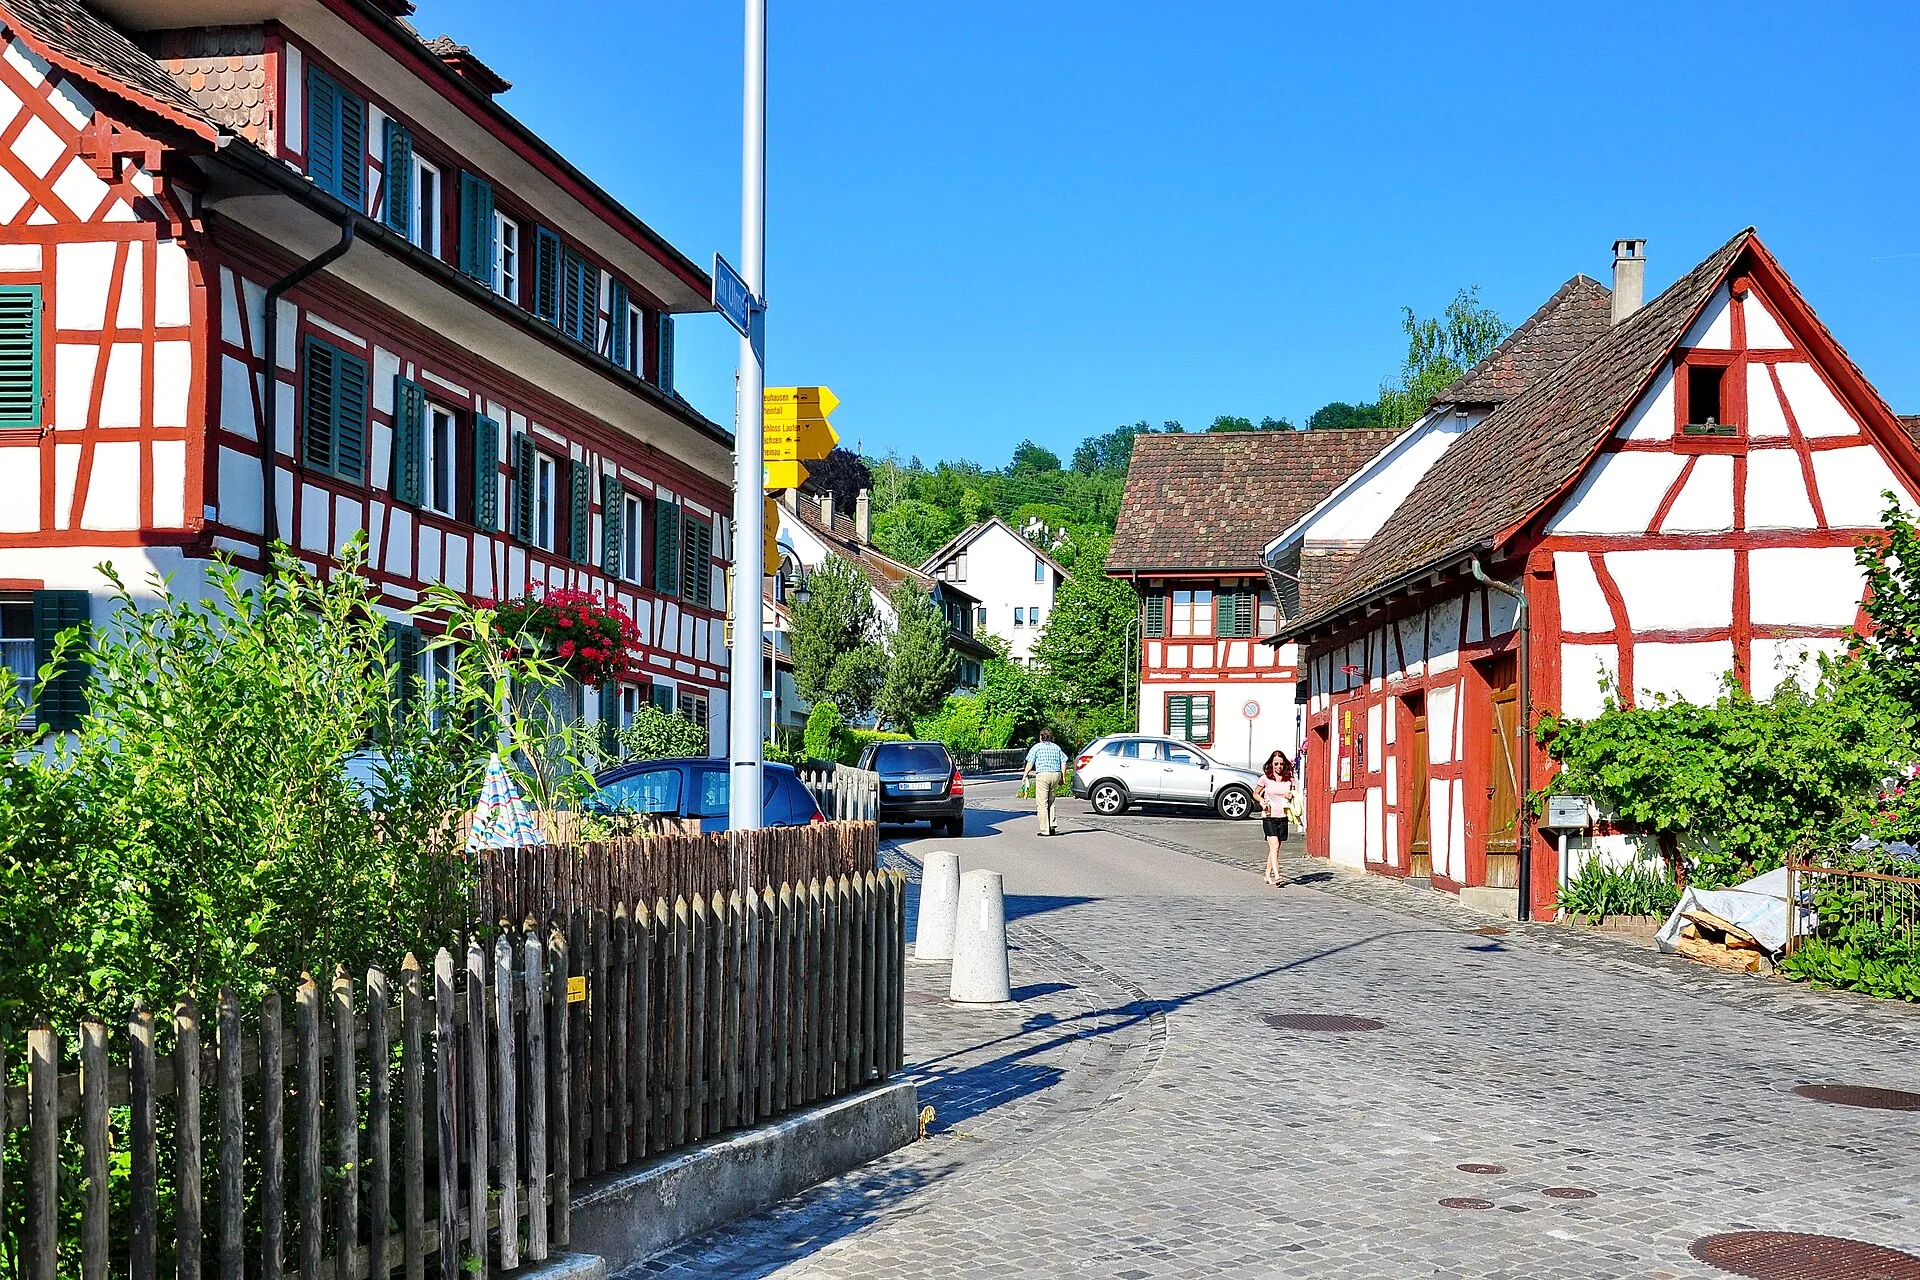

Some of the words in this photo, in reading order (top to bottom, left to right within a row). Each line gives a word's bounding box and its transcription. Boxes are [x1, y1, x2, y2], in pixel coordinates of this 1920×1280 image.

[763, 394, 789, 402] euhausen
[763, 406, 782, 414] heinfall
[763, 424, 781, 432] chloss
[782, 424, 800, 432] Laufen
[763, 436, 782, 444] achsen
